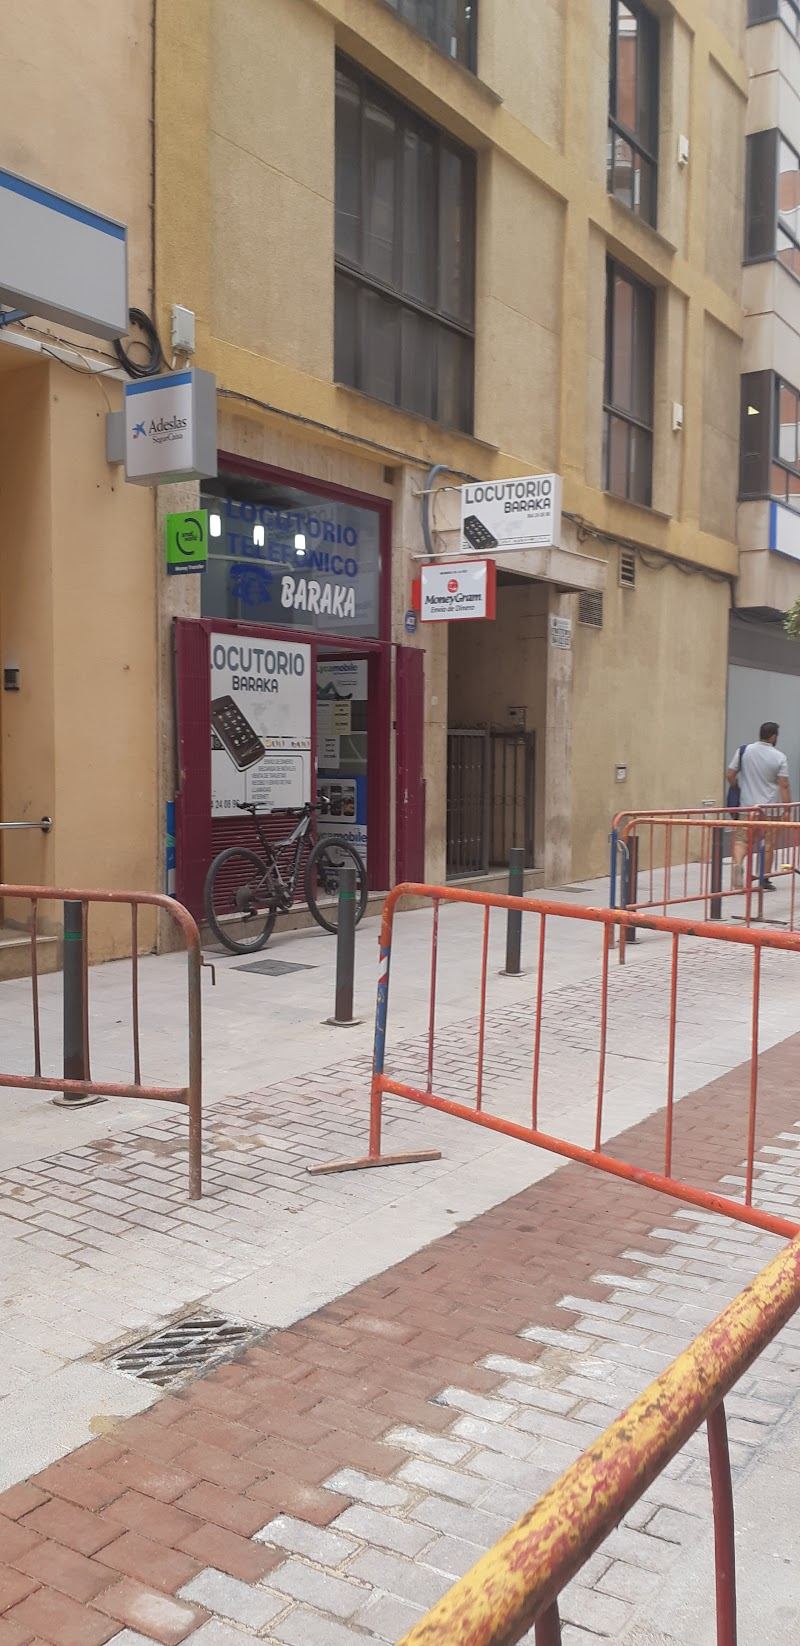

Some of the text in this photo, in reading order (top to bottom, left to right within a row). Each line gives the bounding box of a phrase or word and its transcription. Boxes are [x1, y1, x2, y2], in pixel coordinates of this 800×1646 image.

[149, 415, 188, 433] Adeslas
[464, 479, 552, 505] LOCUTORIO
[503, 498, 552, 513] BARAKA
[225, 496, 358, 547] LOCUTORIO
[281, 575, 356, 618] BARAKA
[425, 593, 483, 605] MoneyGram
[211, 644, 305, 676] OCUTORIO
[232, 675, 279, 693] BARAKA
